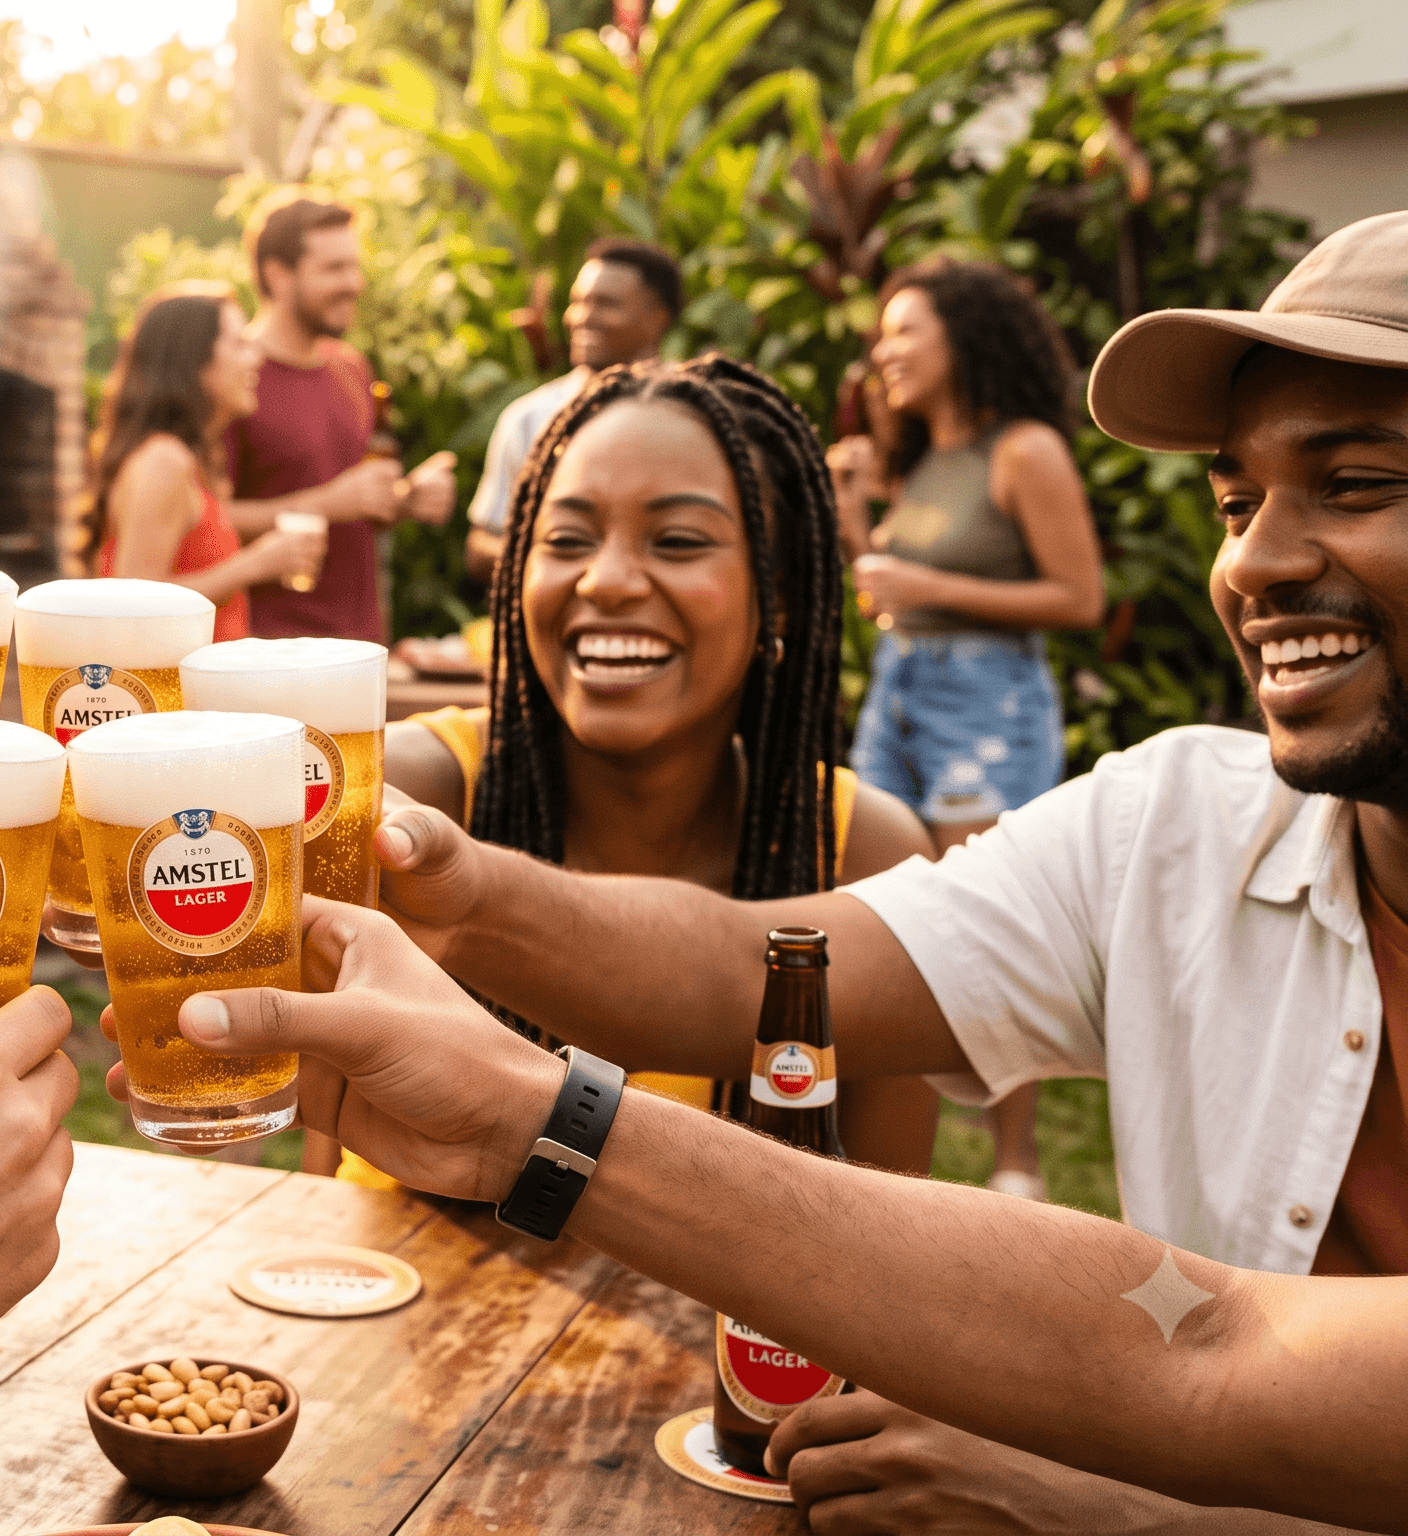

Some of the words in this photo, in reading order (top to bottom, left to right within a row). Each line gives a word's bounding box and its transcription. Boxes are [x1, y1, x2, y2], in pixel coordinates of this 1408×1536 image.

[152, 858, 247, 885] AMSTEL
[174, 890, 227, 907] LAGER
[748, 1346, 810, 1368] LAGER
